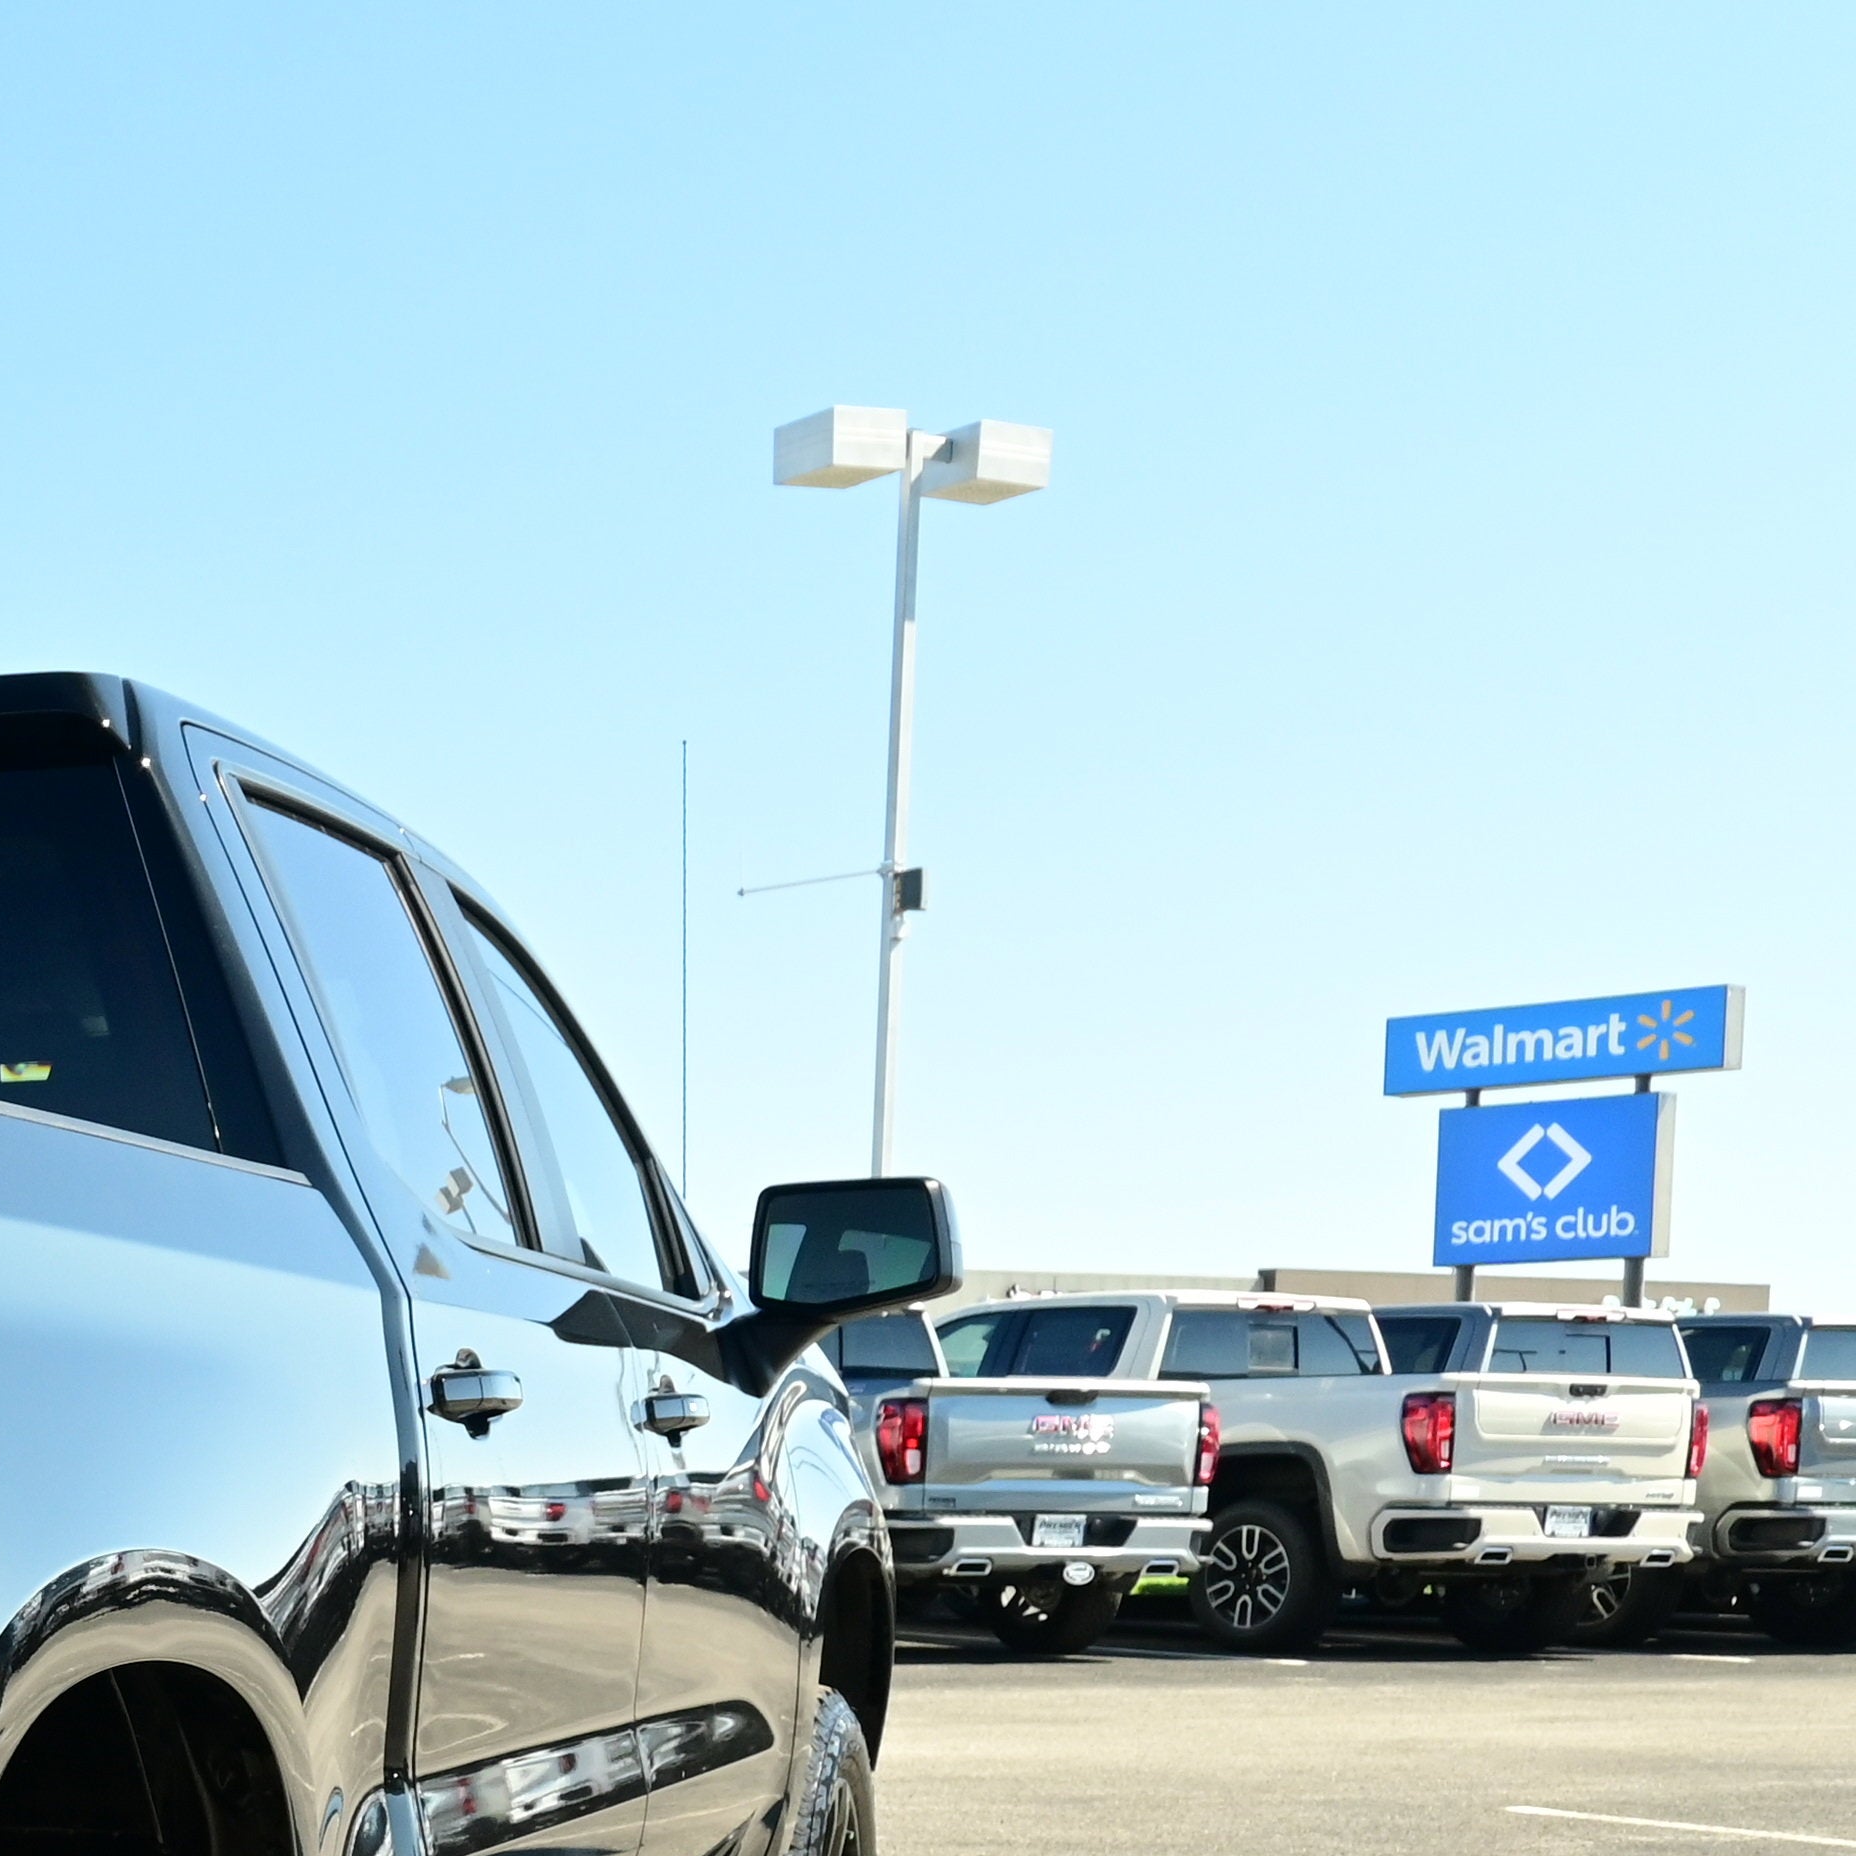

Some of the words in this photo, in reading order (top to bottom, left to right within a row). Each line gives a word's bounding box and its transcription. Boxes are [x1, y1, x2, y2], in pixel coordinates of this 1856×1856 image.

[1415, 1013, 1626, 1071] Walmart
[1451, 1211, 1547, 1246] sam's
[1555, 1205, 1636, 1238] club
